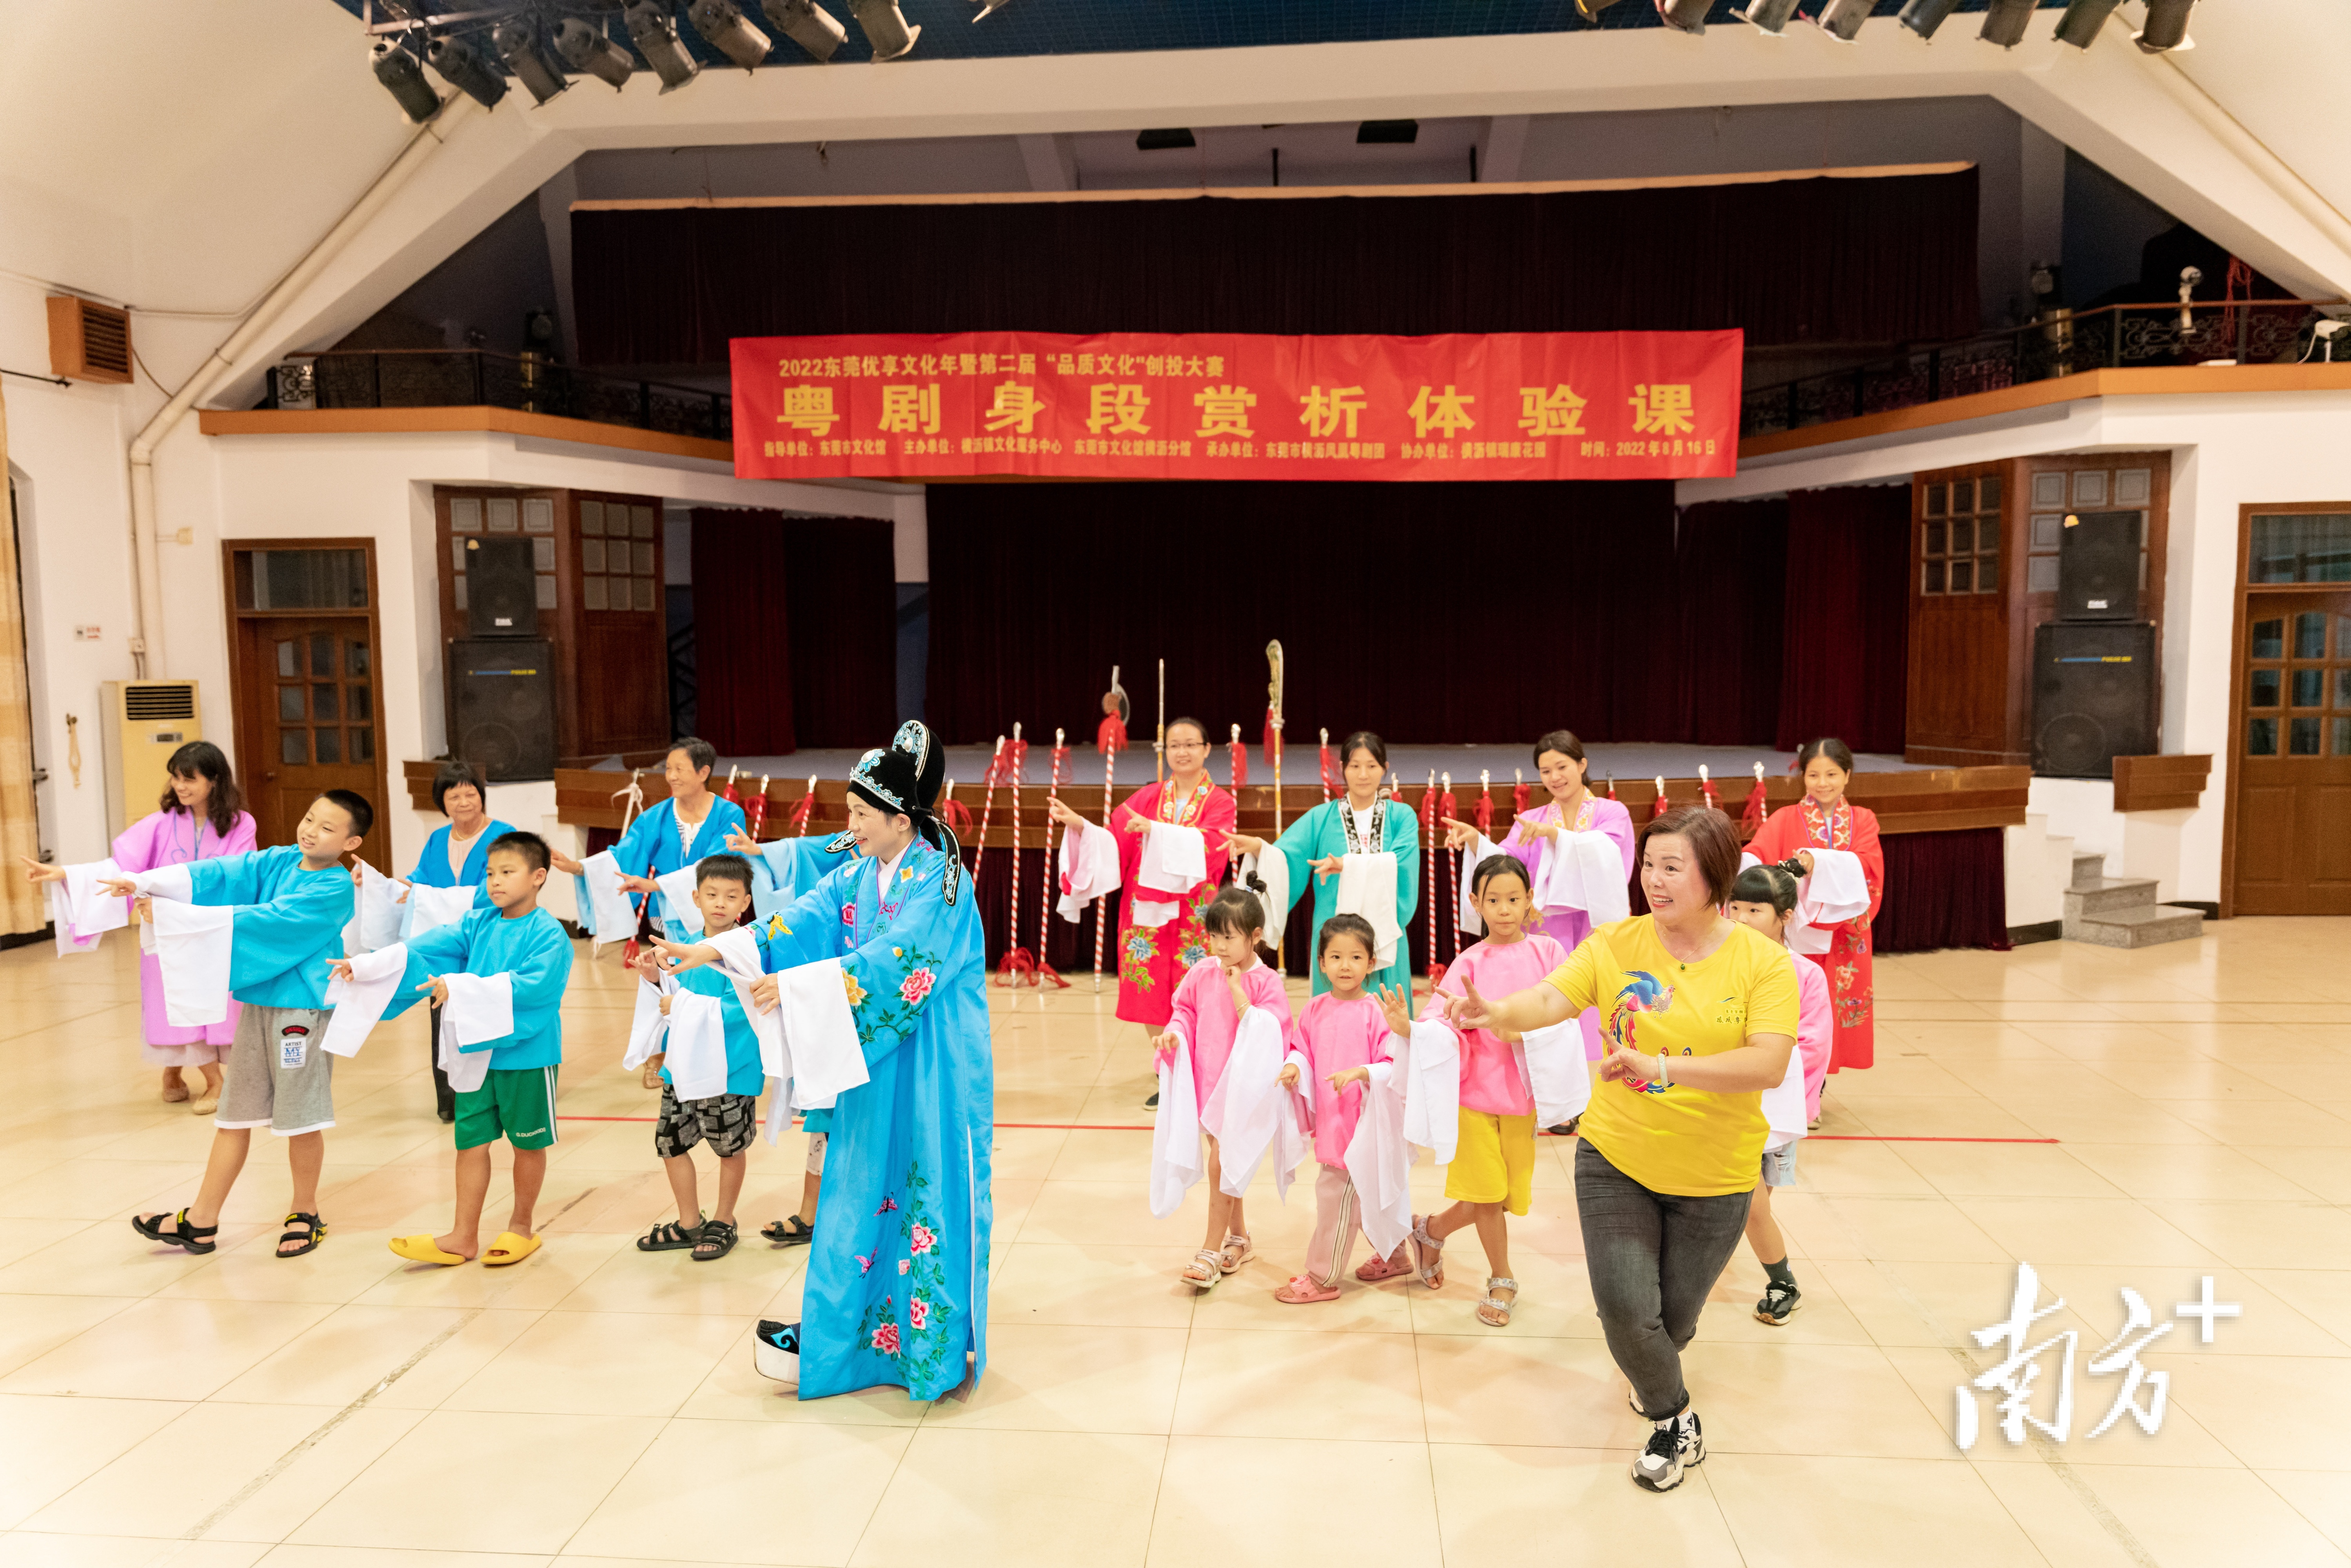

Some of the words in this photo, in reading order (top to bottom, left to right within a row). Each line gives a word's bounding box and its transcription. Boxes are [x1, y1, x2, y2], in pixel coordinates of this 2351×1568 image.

[777, 381, 1695, 437] 粤剧身段赏析体验课
